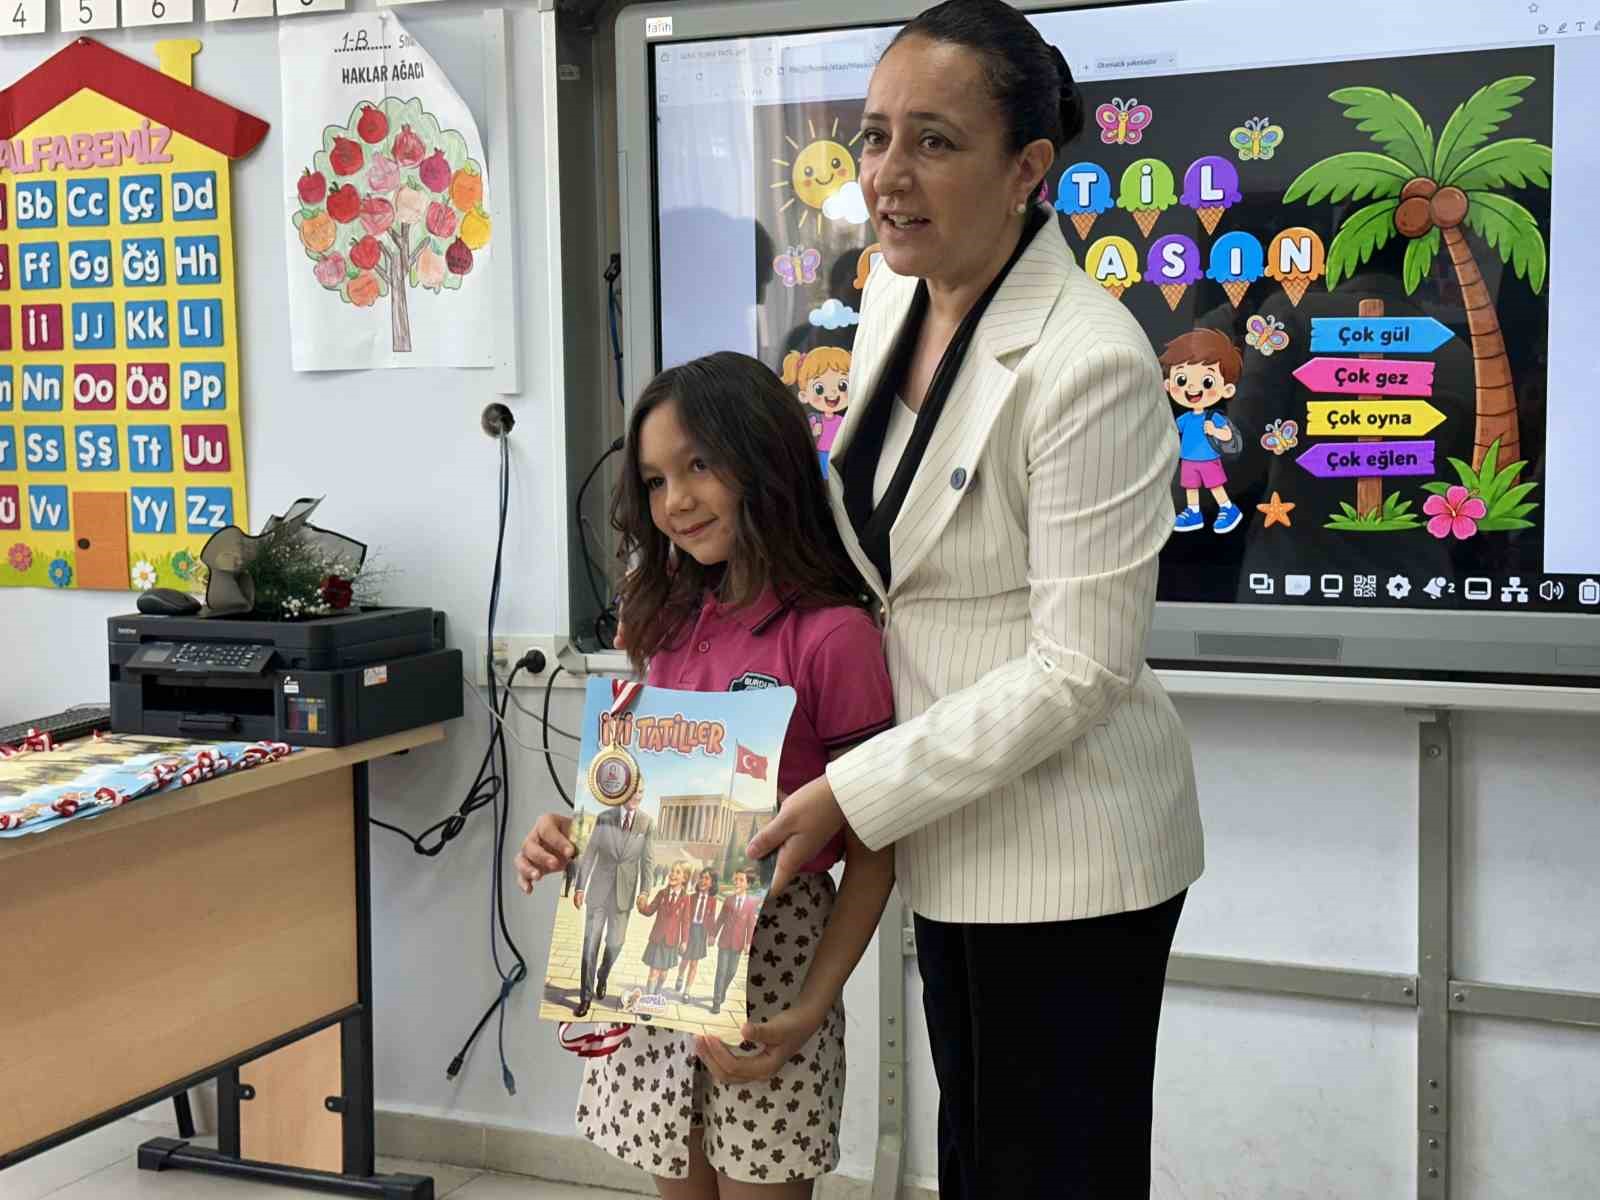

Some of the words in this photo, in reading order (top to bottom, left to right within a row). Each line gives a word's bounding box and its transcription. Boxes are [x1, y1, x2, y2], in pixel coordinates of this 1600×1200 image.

[12, 2, 27, 28] 4
[79, 0, 93, 23] 5
[342, 64, 388, 84] HAKLAR
[392, 59, 424, 81] AĞACI
[0, 119, 173, 174] ALFABEMİZ
[17, 187, 53, 220] Bb
[67, 186, 104, 218] Cc
[122, 183, 155, 221] Çç
[173, 178, 214, 213] Dd
[1071, 164, 1224, 207] TİL
[25, 251, 51, 284] Ff
[69, 249, 110, 283] Gg
[122, 242, 161, 283] Ğğ
[175, 244, 218, 278] Hh
[1095, 236, 1312, 281] ASIN
[74, 311, 103, 343] Jj
[127, 306, 165, 341] Kk
[183, 305, 212, 339] Ll
[1338, 326, 1374, 345] Çok
[1380, 326, 1410, 345] gül
[22, 371, 60, 401] Nn
[74, 372, 113, 404] Oo
[126, 366, 168, 405] Öö
[183, 370, 222, 407] Pp
[1334, 367, 1370, 387] Çok
[1376, 371, 1408, 387] gez
[1327, 410, 1361, 428] Çok
[1367, 412, 1412, 428] oyna
[27, 432, 60, 464] Ss
[78, 430, 113, 468] Şş
[132, 434, 162, 467] Tt
[183, 434, 224, 466] Uu
[1326, 452, 1360, 471] Çok
[1366, 450, 1418, 470] eğlen
[0, 495, 16, 524] ü
[29, 494, 62, 527] Vv
[132, 496, 169, 532] Yy
[187, 495, 226, 528] Zz
[600, 711, 633, 746] İİ
